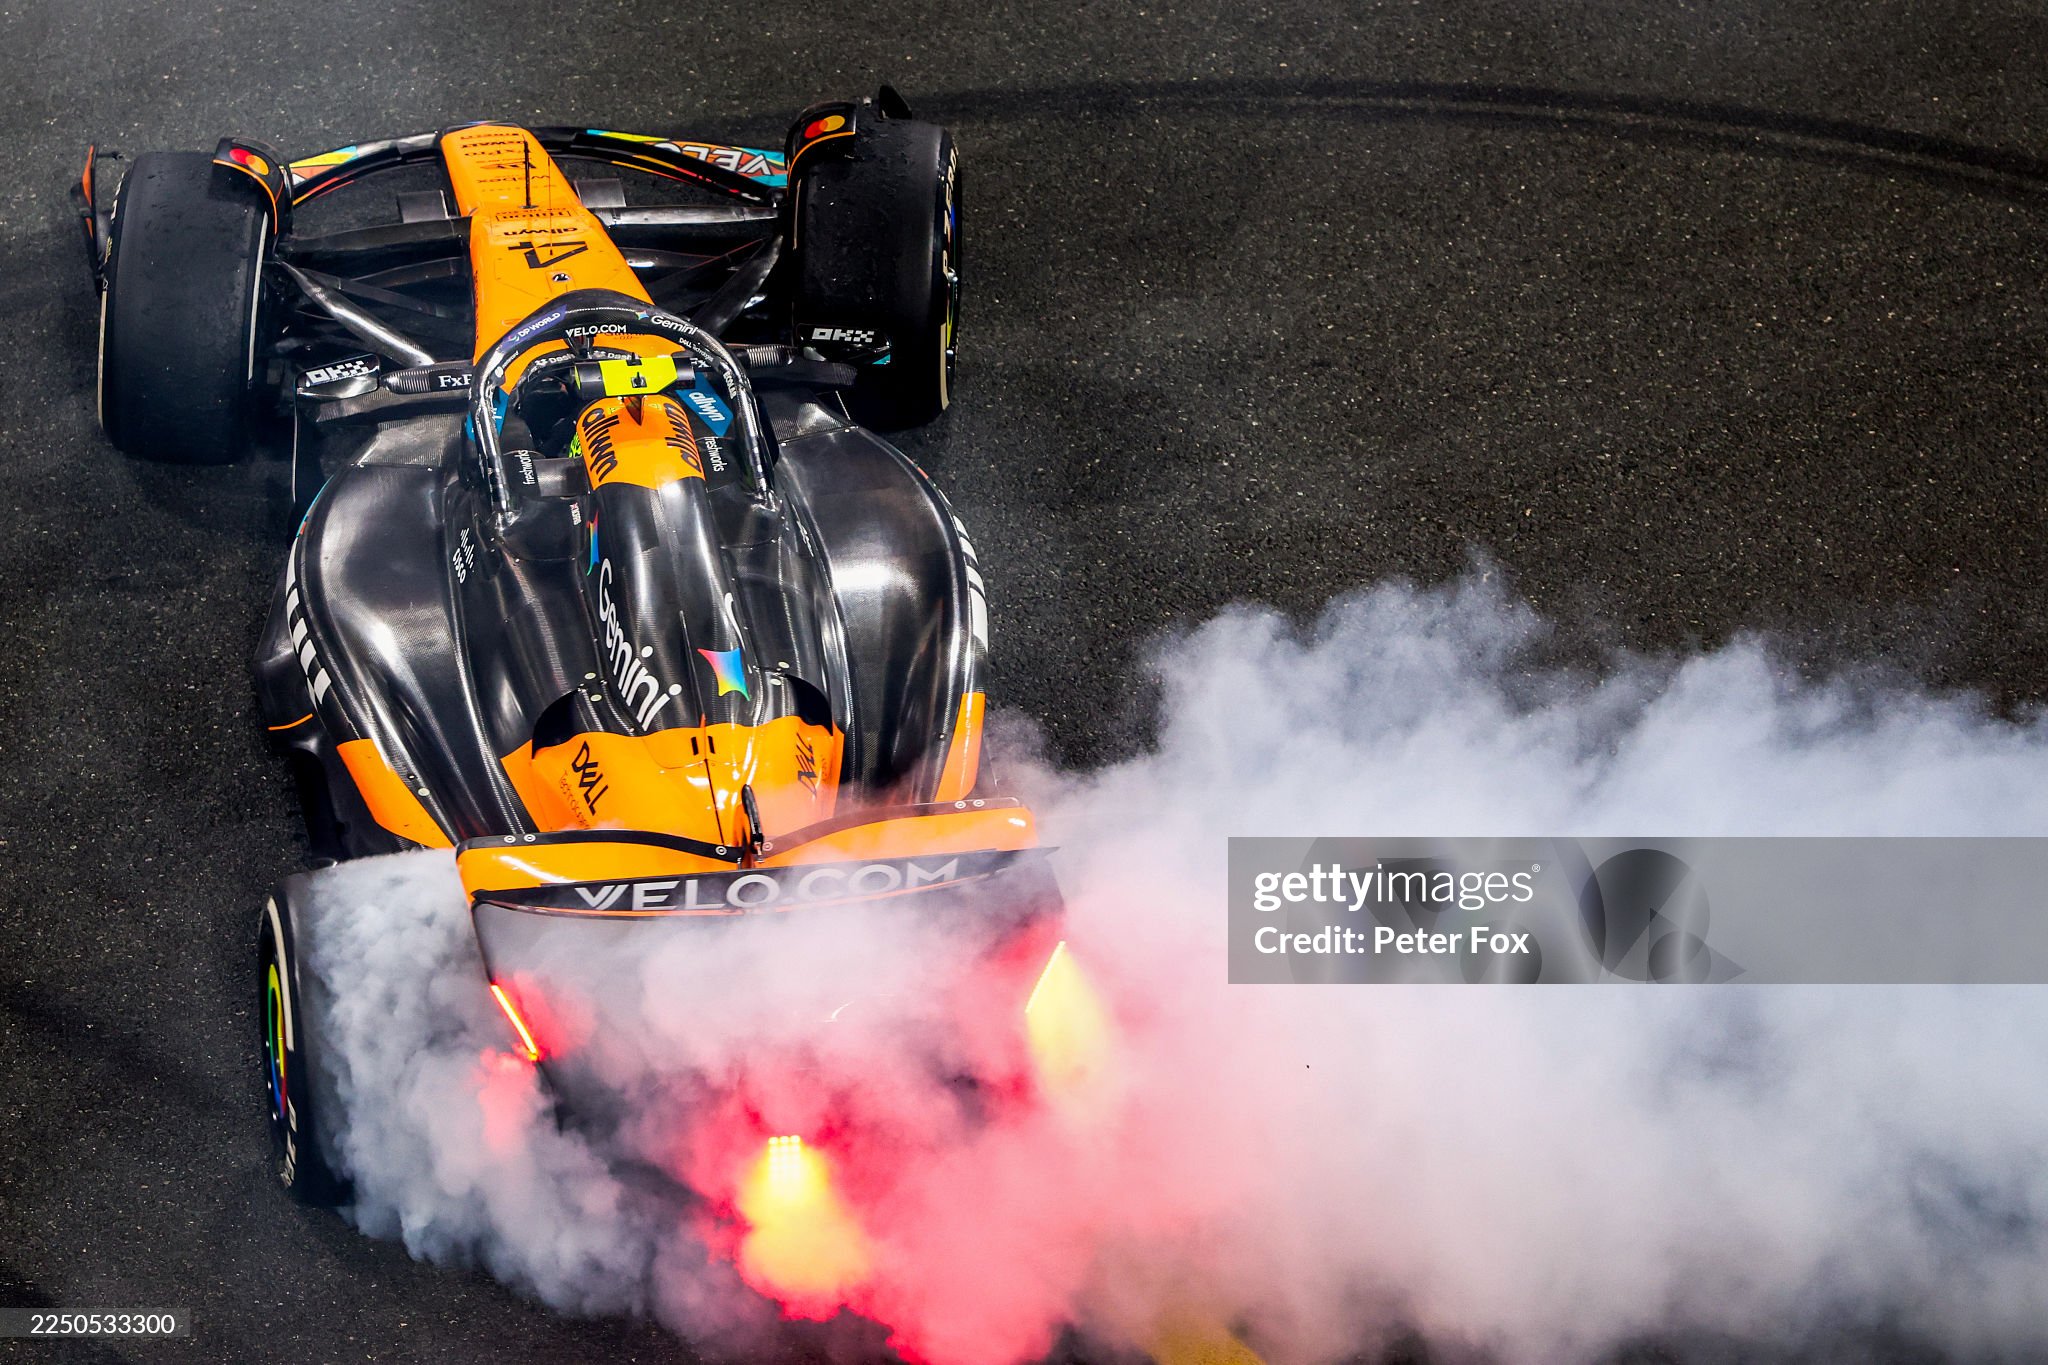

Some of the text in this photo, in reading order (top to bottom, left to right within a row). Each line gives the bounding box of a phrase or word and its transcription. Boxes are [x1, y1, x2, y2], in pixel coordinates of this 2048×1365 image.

[503, 226, 578, 236] allwyn
[508, 241, 589, 269] 4
[517, 312, 561, 337] DP WORLD
[565, 324, 627, 338] VELO.COM
[651, 315, 699, 336] Gemini
[811, 327, 875, 343] OKX
[306, 360, 370, 384] OKX
[689, 392, 726, 422] allwyn
[582, 407, 620, 483] allwyn
[663, 402, 702, 474] allwyn
[514, 449, 536, 485] freshworks
[703, 436, 728, 472] freshworks
[600, 558, 683, 732] Gemini
[571, 740, 609, 816] DELL
[574, 857, 959, 912] VELO.COM
